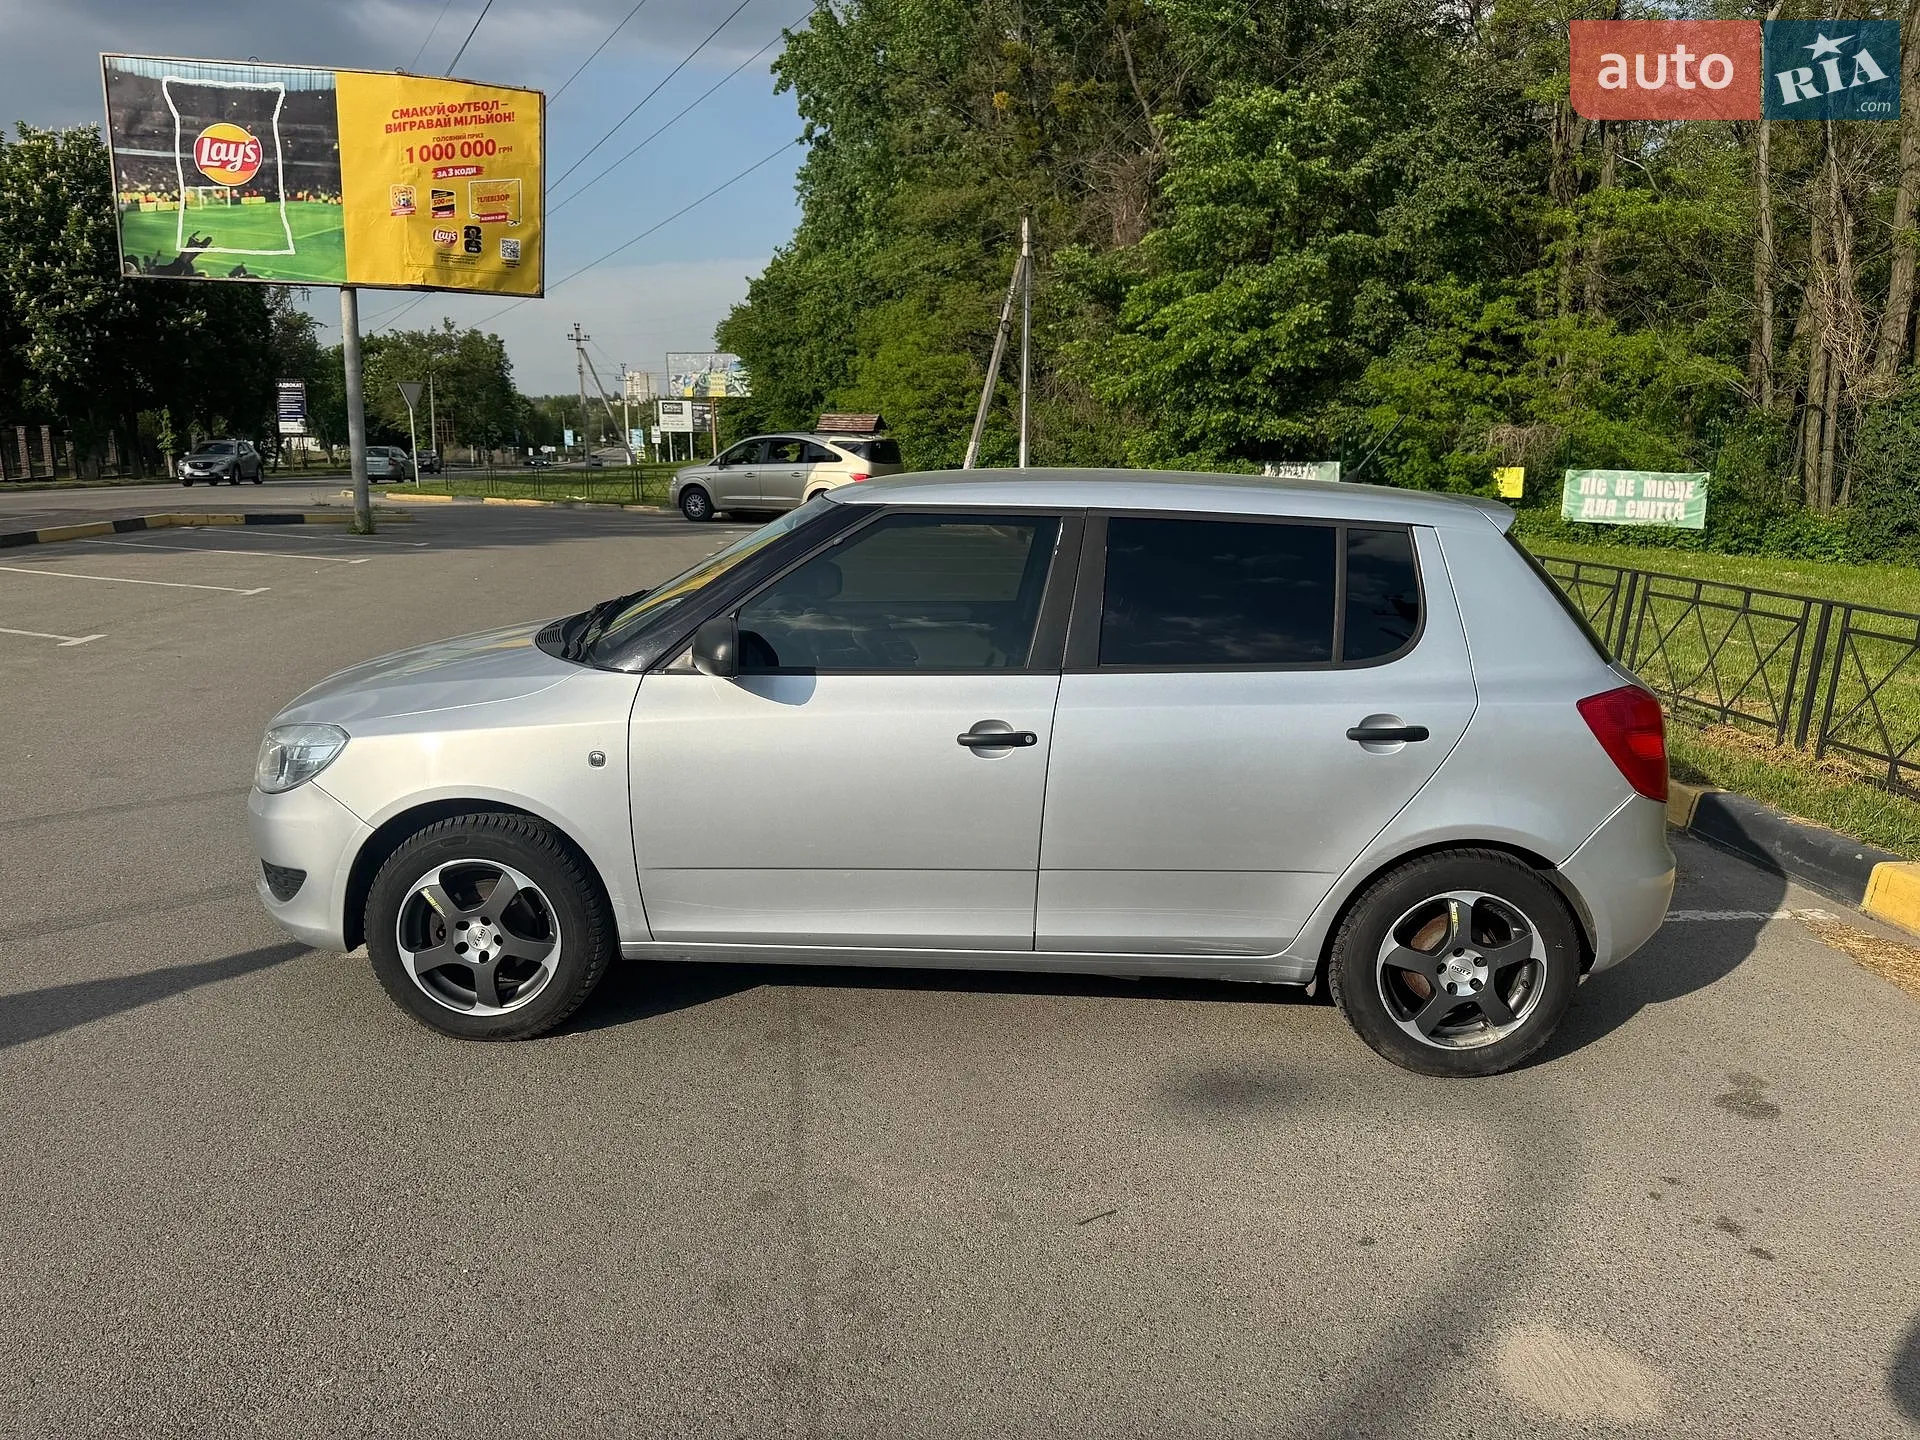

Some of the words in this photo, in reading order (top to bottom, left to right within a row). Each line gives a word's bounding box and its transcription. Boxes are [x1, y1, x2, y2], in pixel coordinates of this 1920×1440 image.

[391, 102, 446, 120] СМАКУЙ
[446, 100, 499, 114] ФУТБОЛ
[385, 114, 452, 134] ВИГРАВАЙ
[453, 111, 515, 127] МІЛЬЙОН!
[200, 138, 258, 172] Lay's
[498, 145, 513, 154] ГРН
[436, 170, 447, 178] ЗА
[447, 168, 453, 177] 3
[454, 166, 477, 176] КОДИ
[477, 194, 510, 203] ТЕЛЕВІЗОР
[1579, 477, 1608, 496] ЛІС
[1614, 478, 1636, 497] НЕ
[1642, 479, 1696, 501] МІСЦЕ
[1581, 497, 1617, 518] ДЛЯ
[1624, 500, 1686, 521] СМІТТЯ
